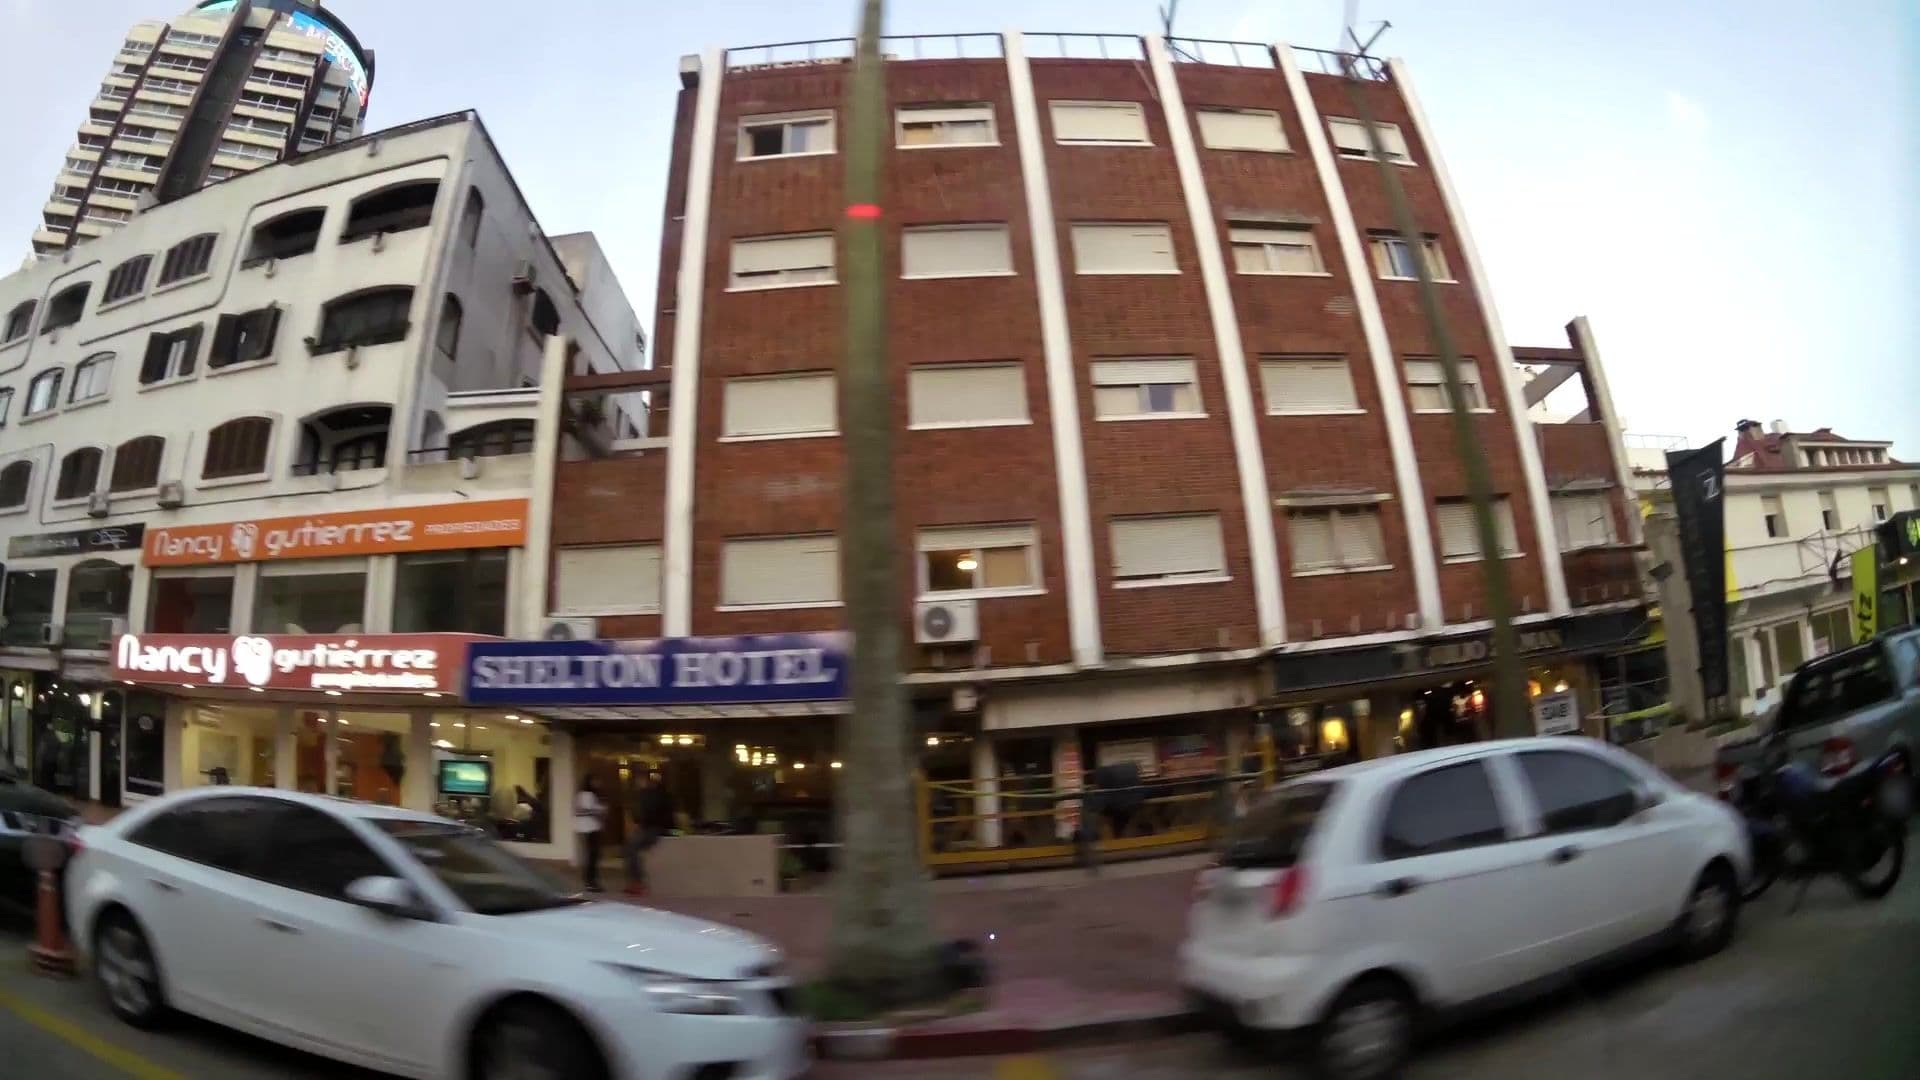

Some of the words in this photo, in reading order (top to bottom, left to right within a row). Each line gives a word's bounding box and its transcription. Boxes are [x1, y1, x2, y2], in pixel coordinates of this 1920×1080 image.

[153, 530, 224, 560] Nancy
[117, 633, 227, 684] Nancy
[471, 654, 662, 689] SHELTON
[671, 648, 838, 687] HOTEL
